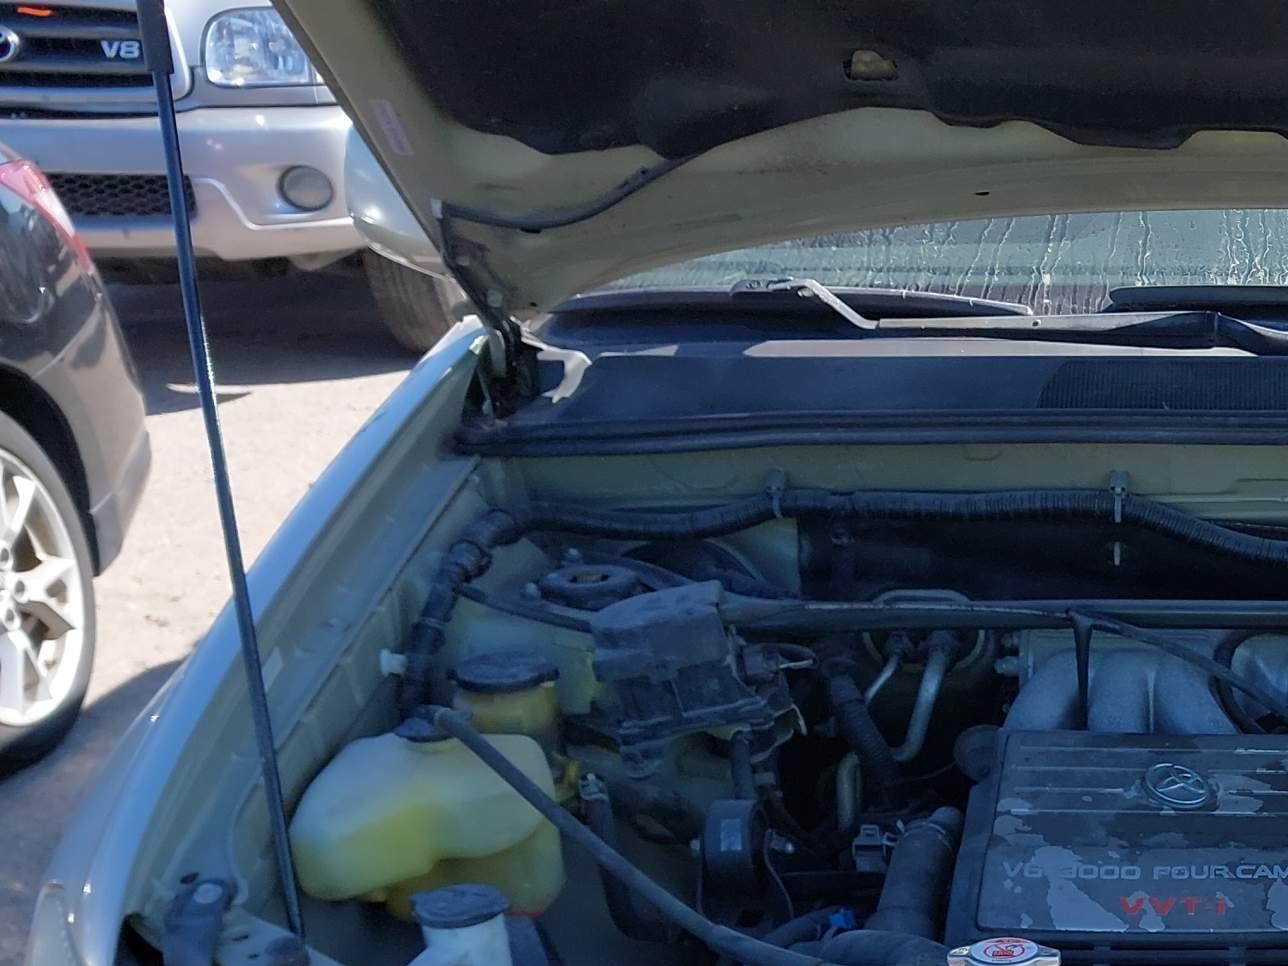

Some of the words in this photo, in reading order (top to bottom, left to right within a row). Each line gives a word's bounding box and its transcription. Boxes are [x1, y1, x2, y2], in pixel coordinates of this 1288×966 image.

[100, 40, 140, 59] V8
[1002, 861, 1043, 879] V6
[1057, 864, 1142, 880] 3000
[1152, 864, 1236, 880] FOUR
